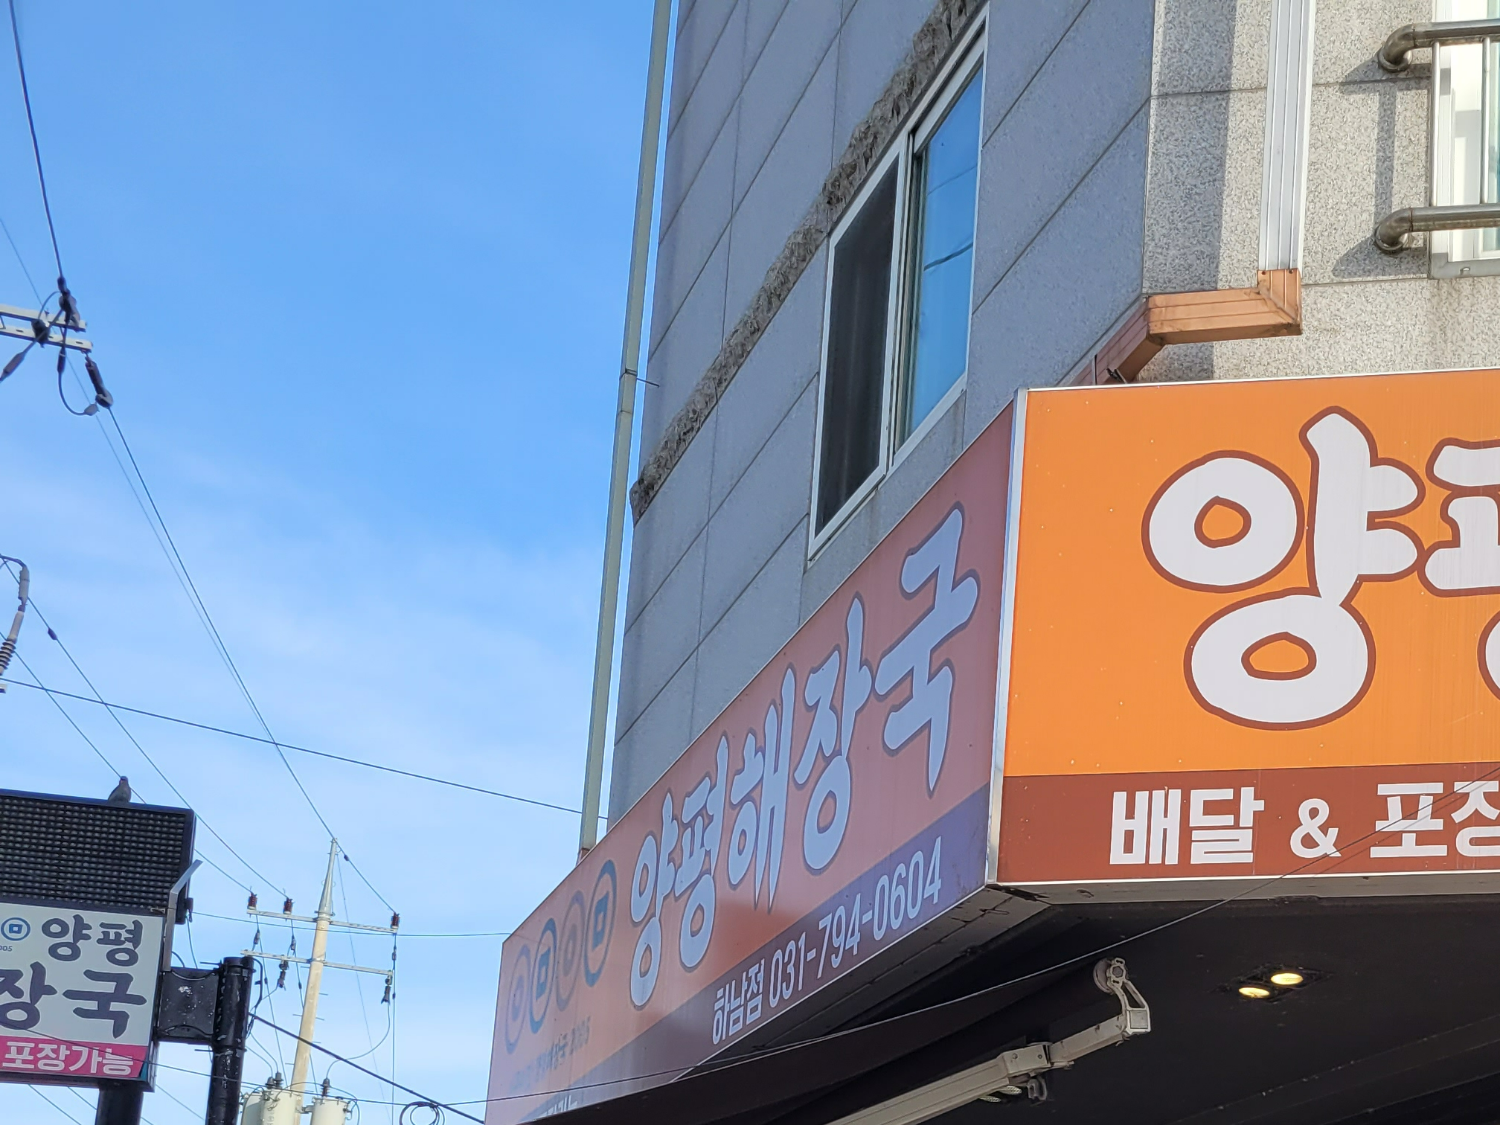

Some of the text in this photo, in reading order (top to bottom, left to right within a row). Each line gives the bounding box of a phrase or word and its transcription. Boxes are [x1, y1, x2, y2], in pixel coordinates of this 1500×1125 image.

[630, 502, 980, 1010] 양평해장국
[1109, 787, 1264, 866] 배달
[1289, 797, 1341, 859] &
[41, 914, 144, 967] 양평
[711, 835, 943, 1045] 하남점 031-794-0604
[2, 1040, 135, 1076] 포장가능
